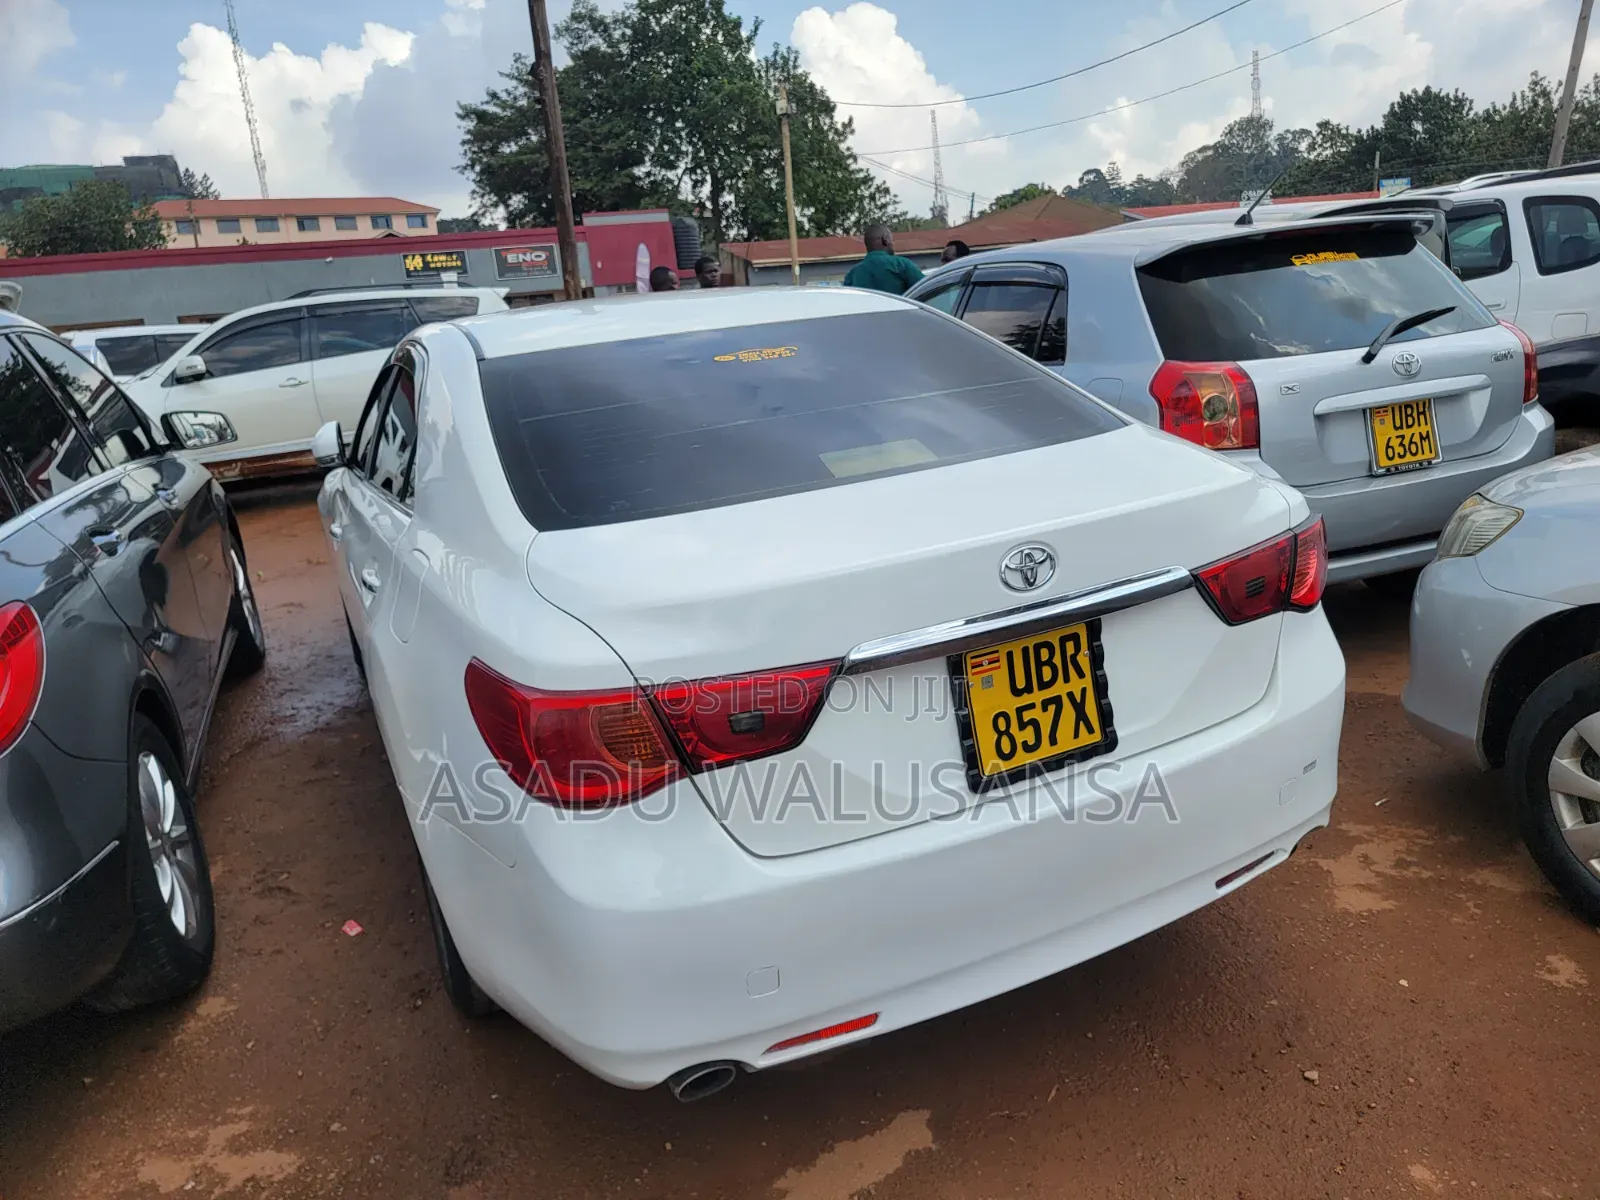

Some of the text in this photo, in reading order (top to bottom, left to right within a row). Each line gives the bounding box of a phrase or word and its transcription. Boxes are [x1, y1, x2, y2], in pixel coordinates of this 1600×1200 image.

[507, 251, 547, 264] ENO
[1391, 401, 1429, 431] UBH
[1385, 430, 1433, 462] 636M
[1398, 463, 1420, 471] TOYOTA
[1006, 632, 1086, 698] UBR
[992, 686, 1096, 762] 857X
